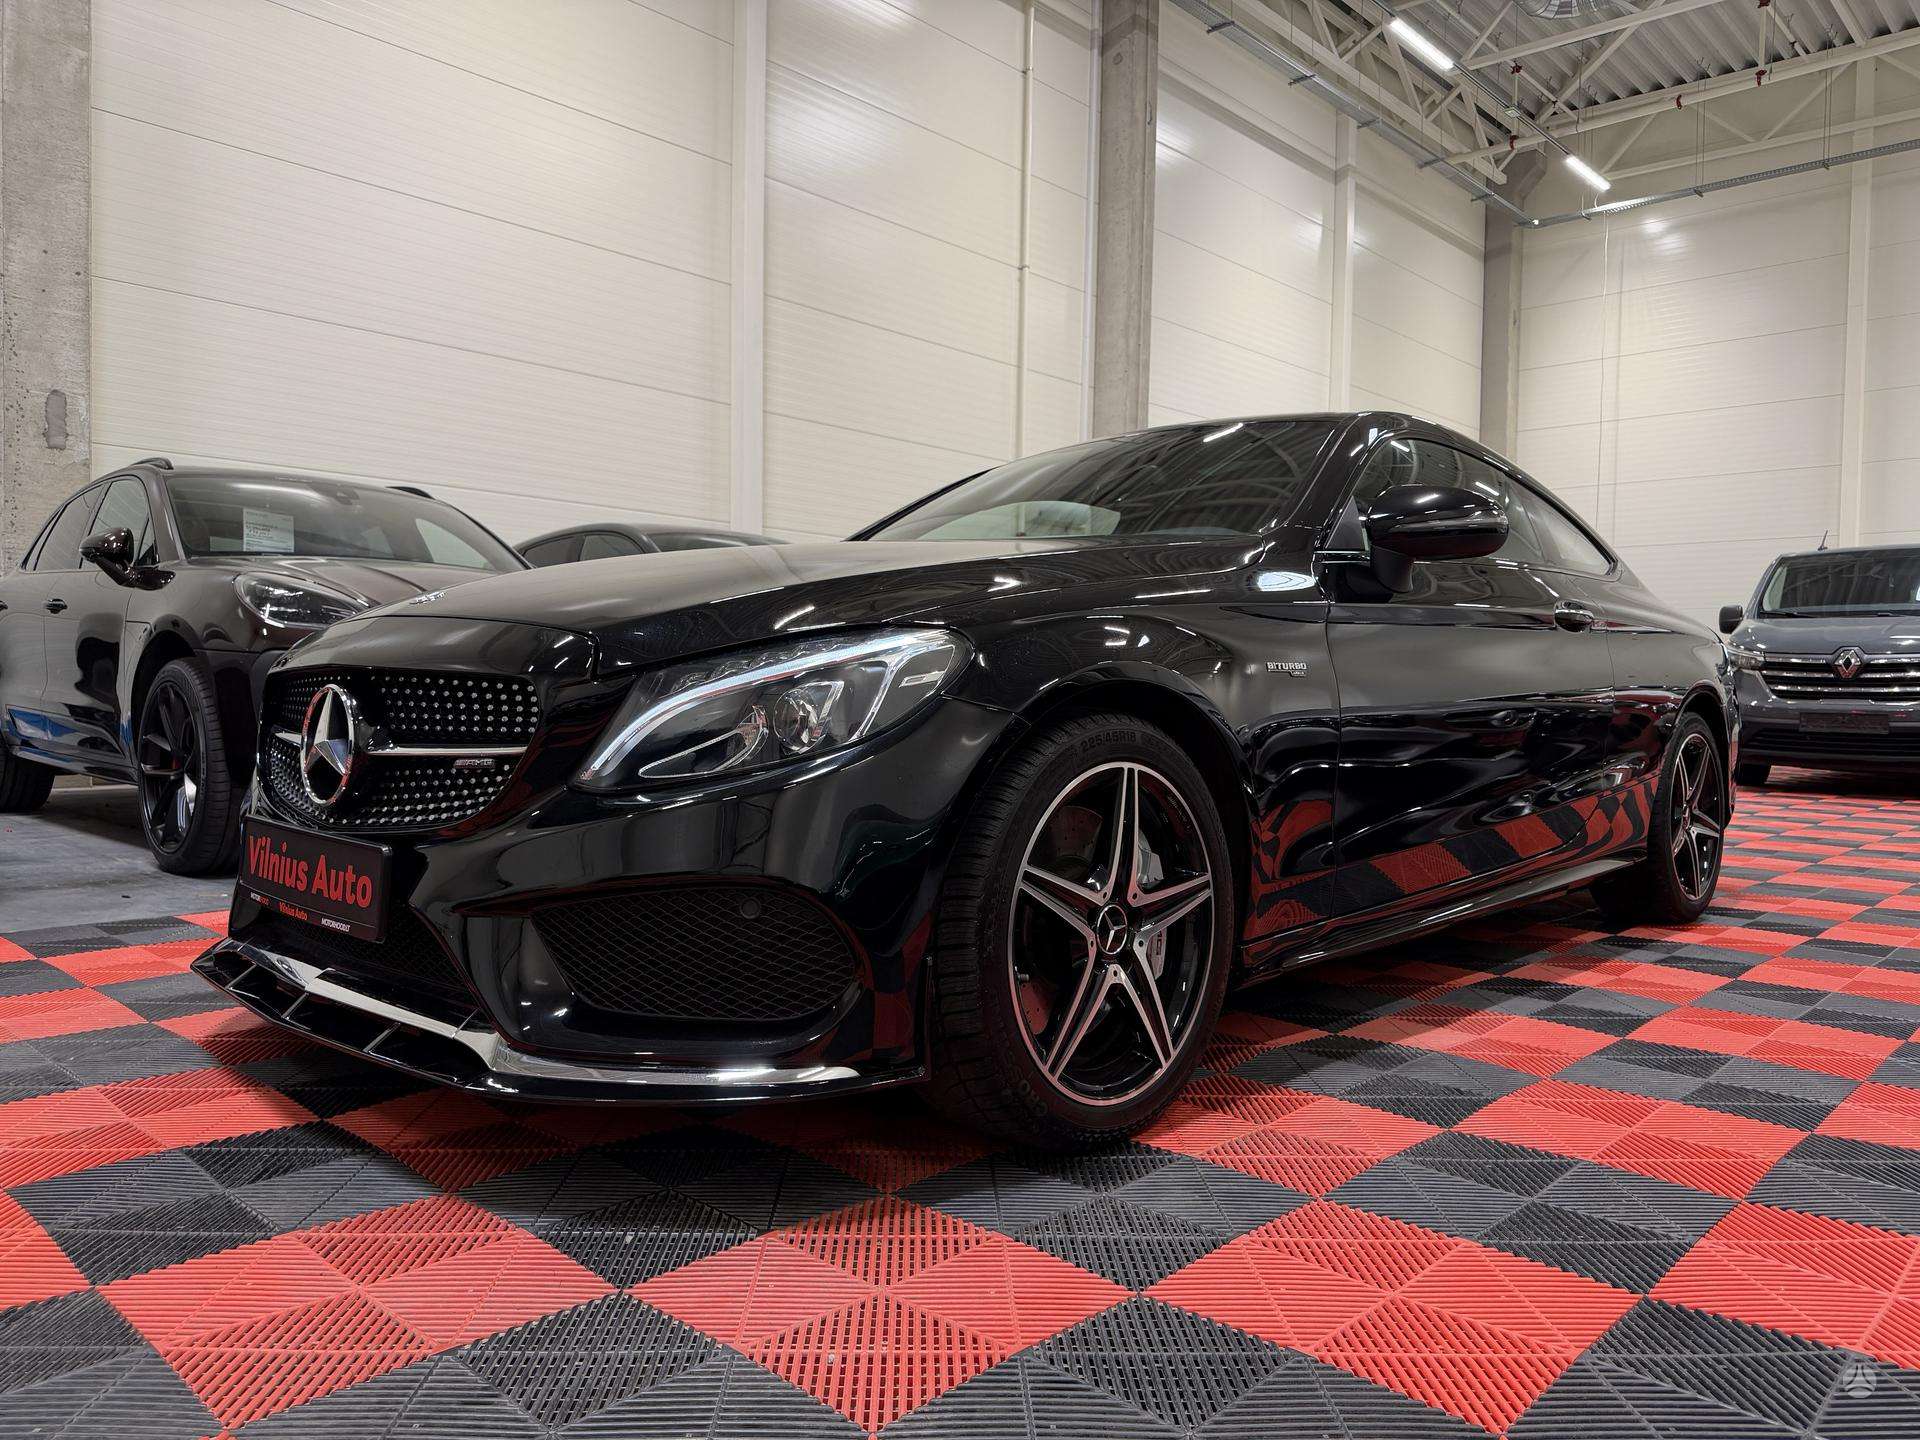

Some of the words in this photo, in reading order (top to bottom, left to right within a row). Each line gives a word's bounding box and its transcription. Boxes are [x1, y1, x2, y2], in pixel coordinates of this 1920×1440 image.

[1266, 661, 1307, 670] BITURBO
[249, 835, 309, 892] Vilnius
[311, 854, 373, 908] Auto
